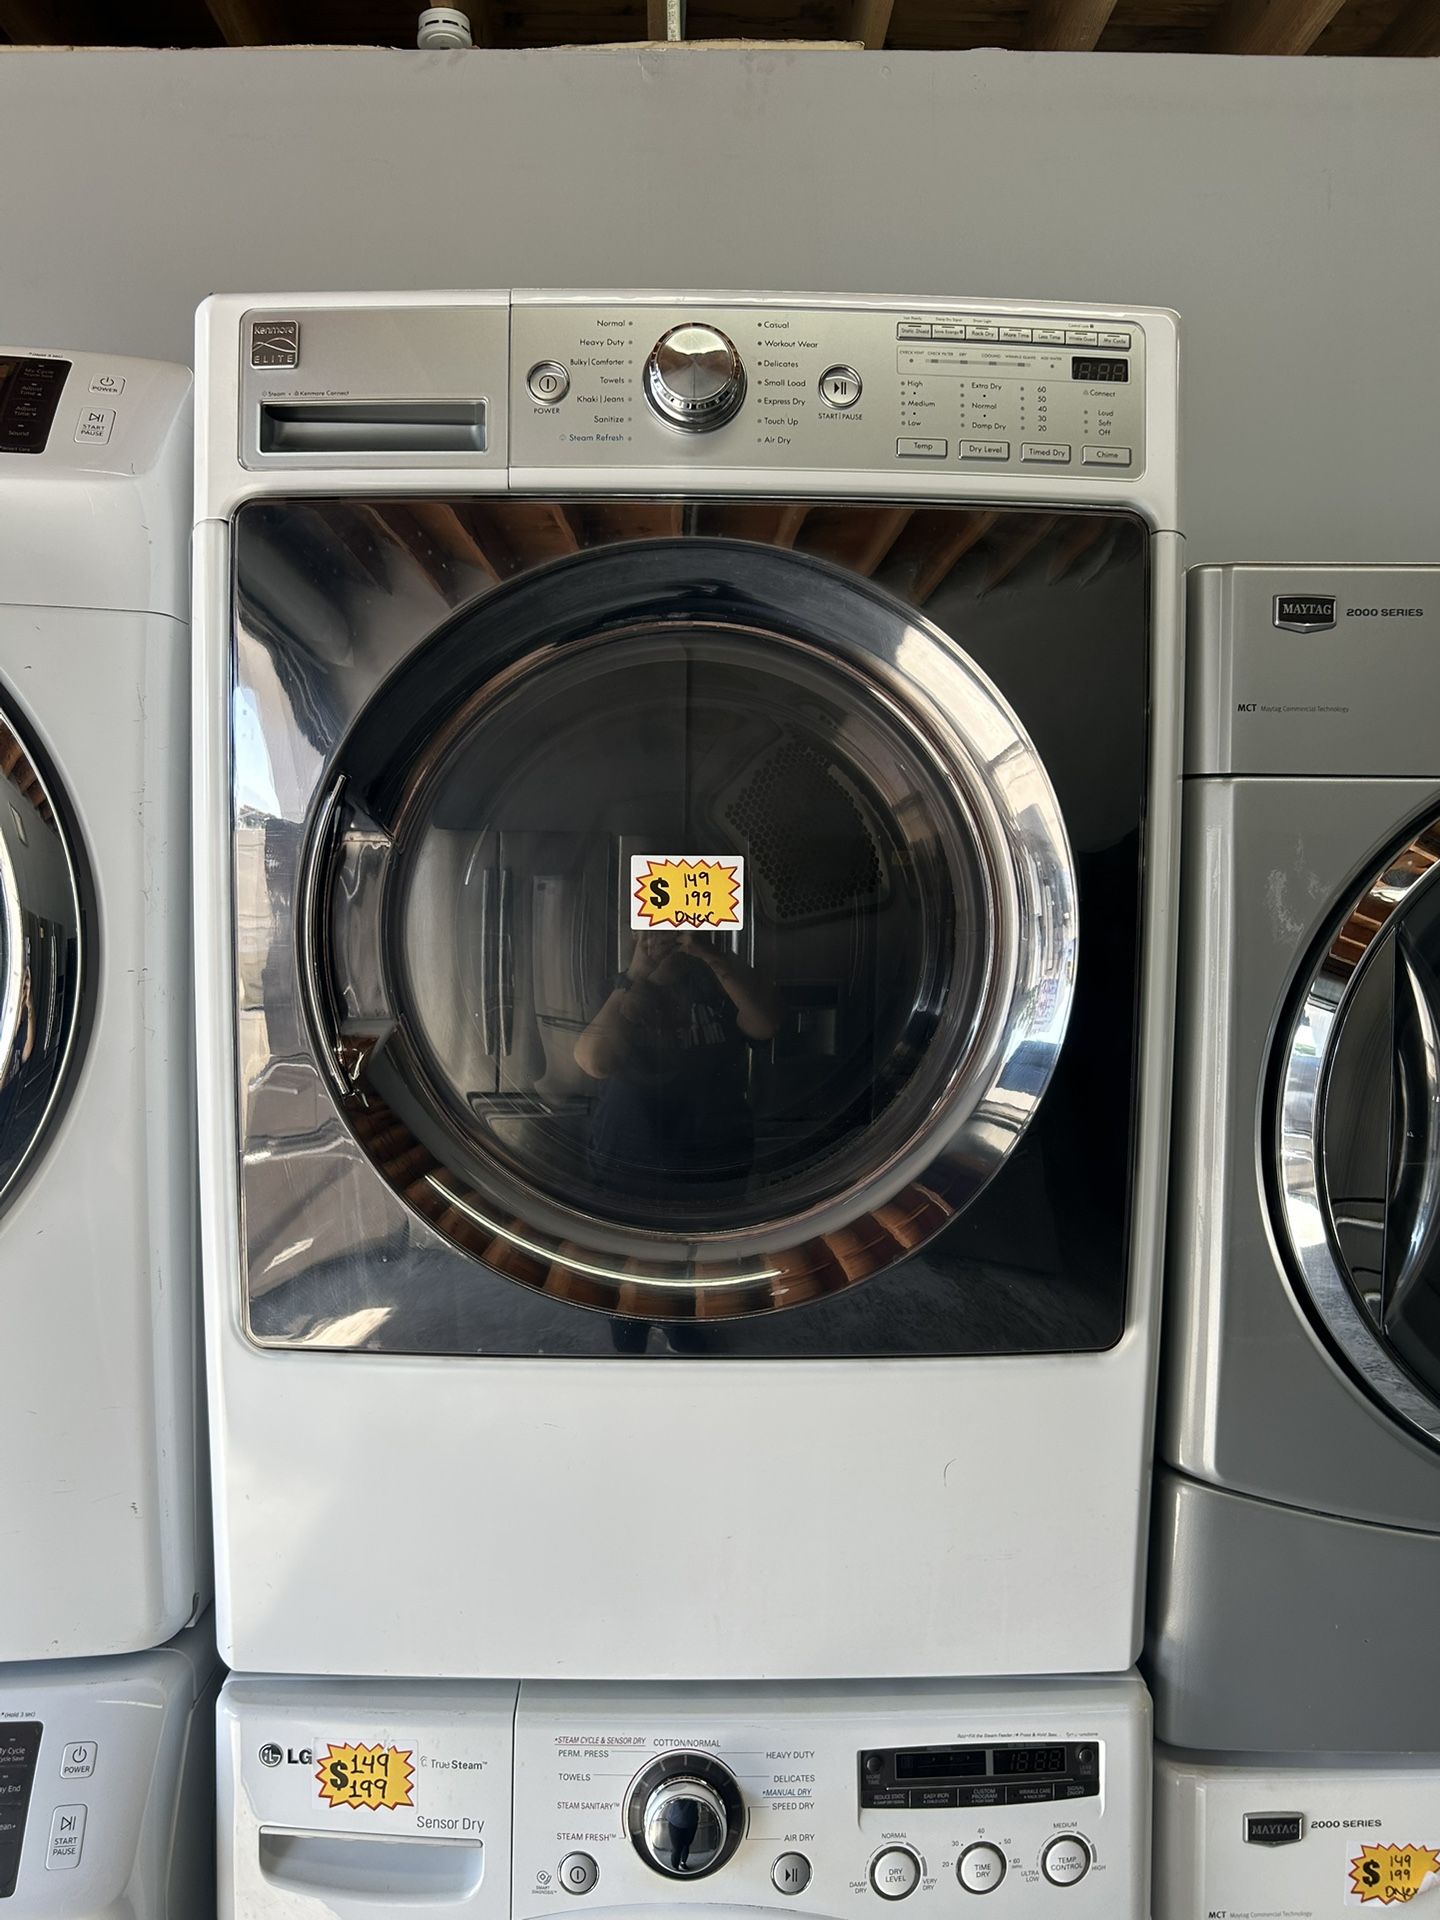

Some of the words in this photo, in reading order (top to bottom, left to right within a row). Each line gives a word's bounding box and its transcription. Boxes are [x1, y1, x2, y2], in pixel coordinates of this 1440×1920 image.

[764, 321, 790, 329] Casual
[254, 326, 294, 334] Kenmore
[580, 338, 604, 347] Heavy
[607, 339, 624, 347] Duty
[765, 340, 797, 348] Workout
[254, 354, 293, 364] ELITE
[764, 360, 799, 368] Delicates
[600, 376, 624, 384] Towels
[764, 379, 785, 387] Small
[908, 380, 923, 388] High
[972, 382, 986, 390] Extra
[764, 398, 792, 406] Express
[793, 398, 806, 407] Dry
[908, 400, 936, 408] Medium
[1038, 405, 1047, 413] 40
[594, 415, 624, 423] Sanitize
[764, 417, 786, 425] Touch
[788, 417, 798, 426] Up
[972, 422, 989, 430] Damp
[991, 423, 1006, 431] Dry
[569, 434, 593, 442] Steam
[596, 434, 624, 442] Refresh
[764, 436, 775, 444] Air
[778, 437, 791, 445] Dry
[970, 446, 983, 454] Dry
[1097, 451, 1118, 459] Chime
[1283, 604, 1332, 615] MAYTAG
[1347, 609, 1378, 617] 2000
[1381, 609, 1423, 617] SERIES
[1238, 704, 1257, 712] MCT
[650, 878, 670, 908] $
[684, 872, 709, 888] 149
[685, 891, 711, 906] 199
[287, 1748, 312, 1764] LG
[558, 1750, 582, 1758] PERM.
[584, 1750, 609, 1758] PRESS
[351, 1754, 389, 1777] 149
[558, 1774, 591, 1782] TOWELS
[349, 1779, 387, 1798] 199
[557, 1802, 580, 1810] STEAM
[772, 1802, 796, 1810] SPEED
[798, 1802, 814, 1810] DRY
[417, 1816, 459, 1830] Sensor
[462, 1818, 485, 1833] Dry
[1311, 1820, 1340, 1828] 2000
[1343, 1819, 1382, 1828] SERIES
[1252, 1824, 1297, 1834] MAYTAG
[54, 1837, 77, 1845] START
[1058, 1856, 1077, 1864] TEMP
[1390, 1855, 1412, 1867] 149
[976, 1870, 990, 1878] DRY
[1390, 1869, 1410, 1881] 199
[1208, 1911, 1227, 1919] MCT
